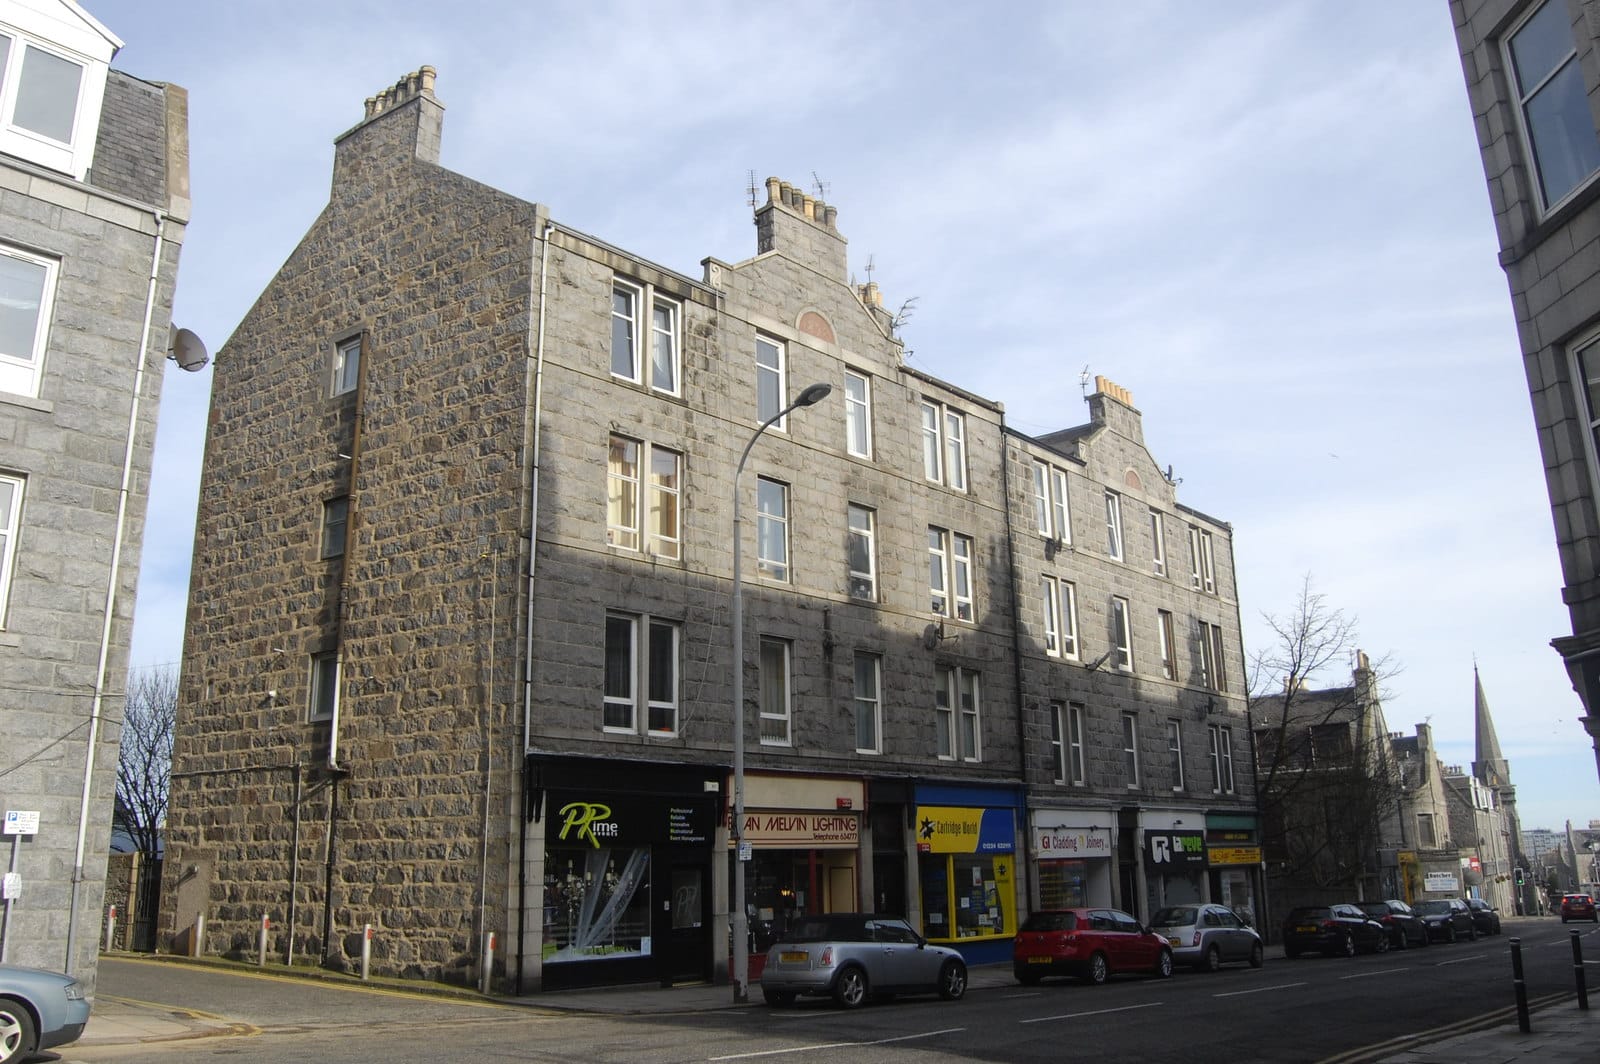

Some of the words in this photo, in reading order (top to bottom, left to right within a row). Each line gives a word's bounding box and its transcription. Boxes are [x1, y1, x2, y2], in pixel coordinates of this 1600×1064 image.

[765, 817, 807, 831] MELVIN
[812, 817, 857, 831] LIGHTING
[936, 821, 961, 837] Cartridge
[962, 821, 978, 834] World
[813, 833, 839, 842] Telephone
[1053, 835, 1077, 852] Cladding
[1086, 835, 1105, 851] Joinery
